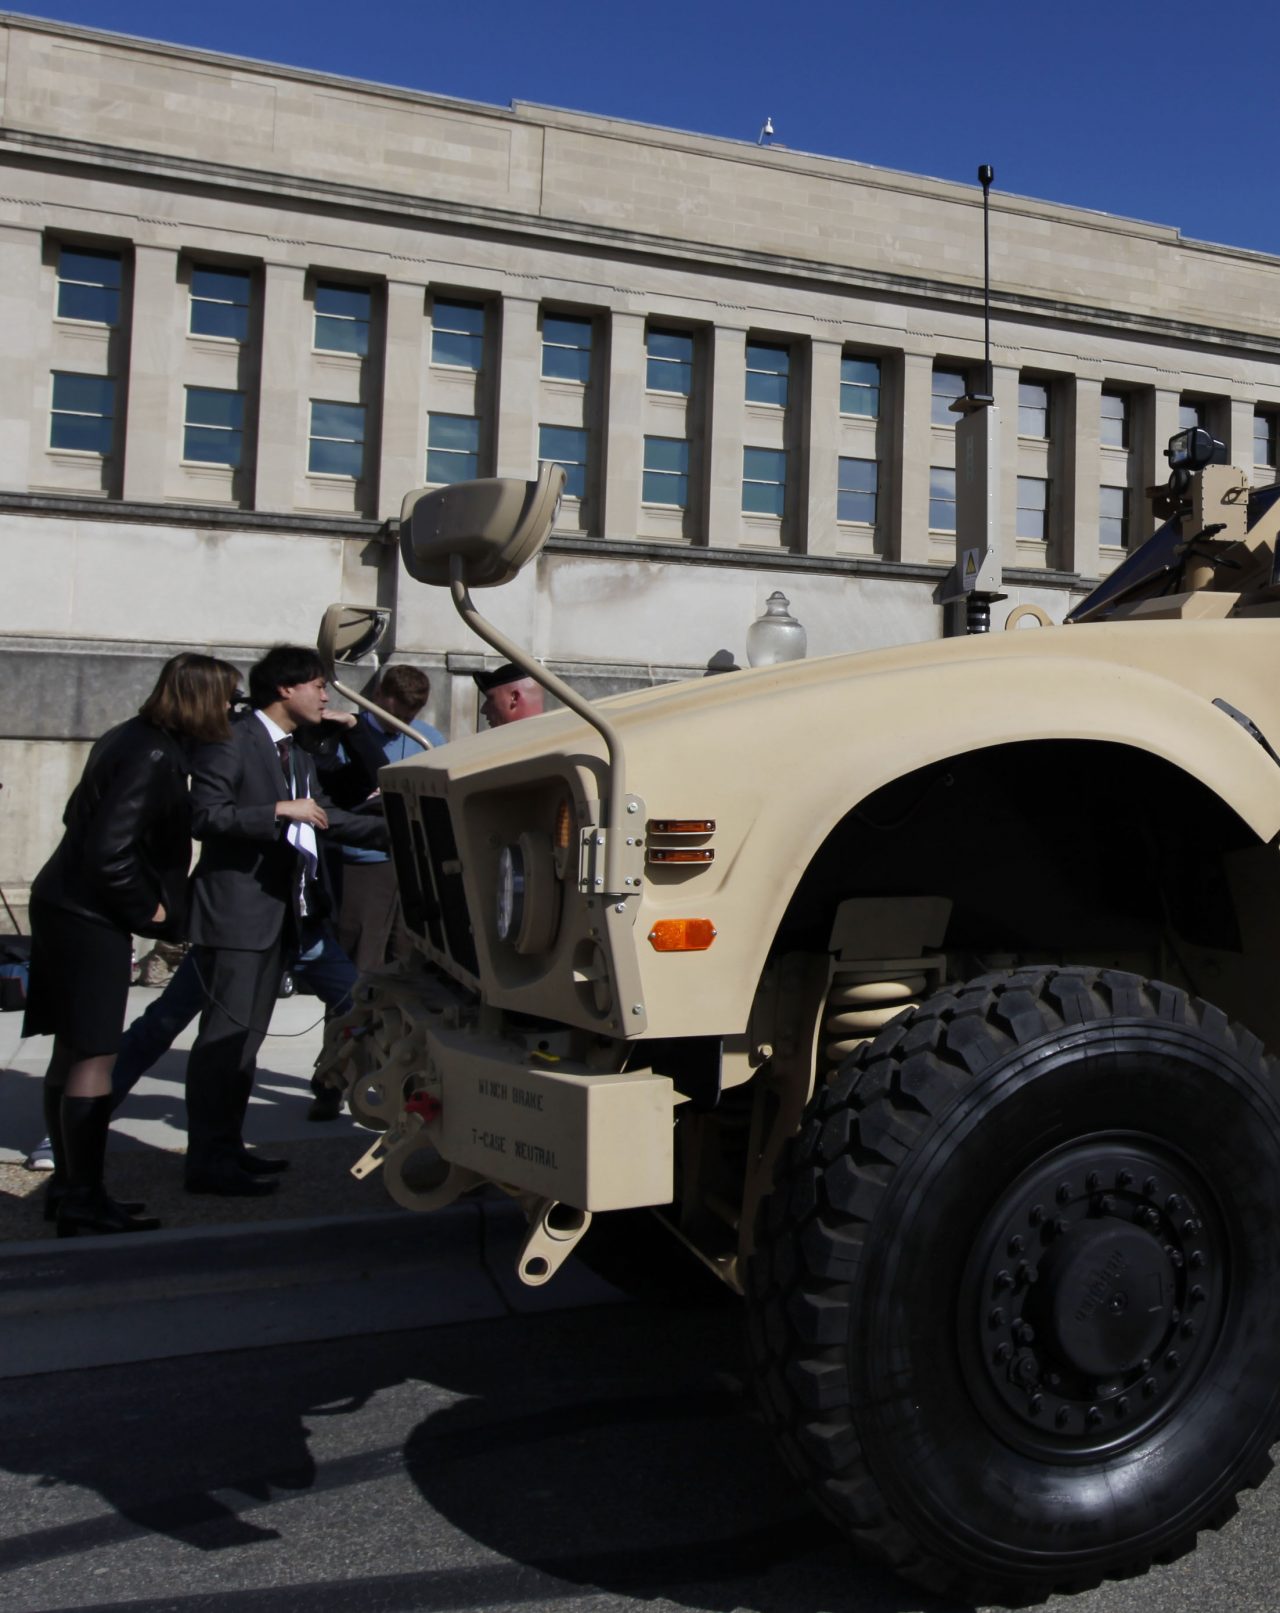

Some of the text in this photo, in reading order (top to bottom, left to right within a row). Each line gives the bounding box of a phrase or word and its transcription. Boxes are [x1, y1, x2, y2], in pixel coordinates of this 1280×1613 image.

[478, 1079, 544, 1112] WINCH BRAKE
[471, 1127, 559, 1170] T-CASE NEUTRAL
